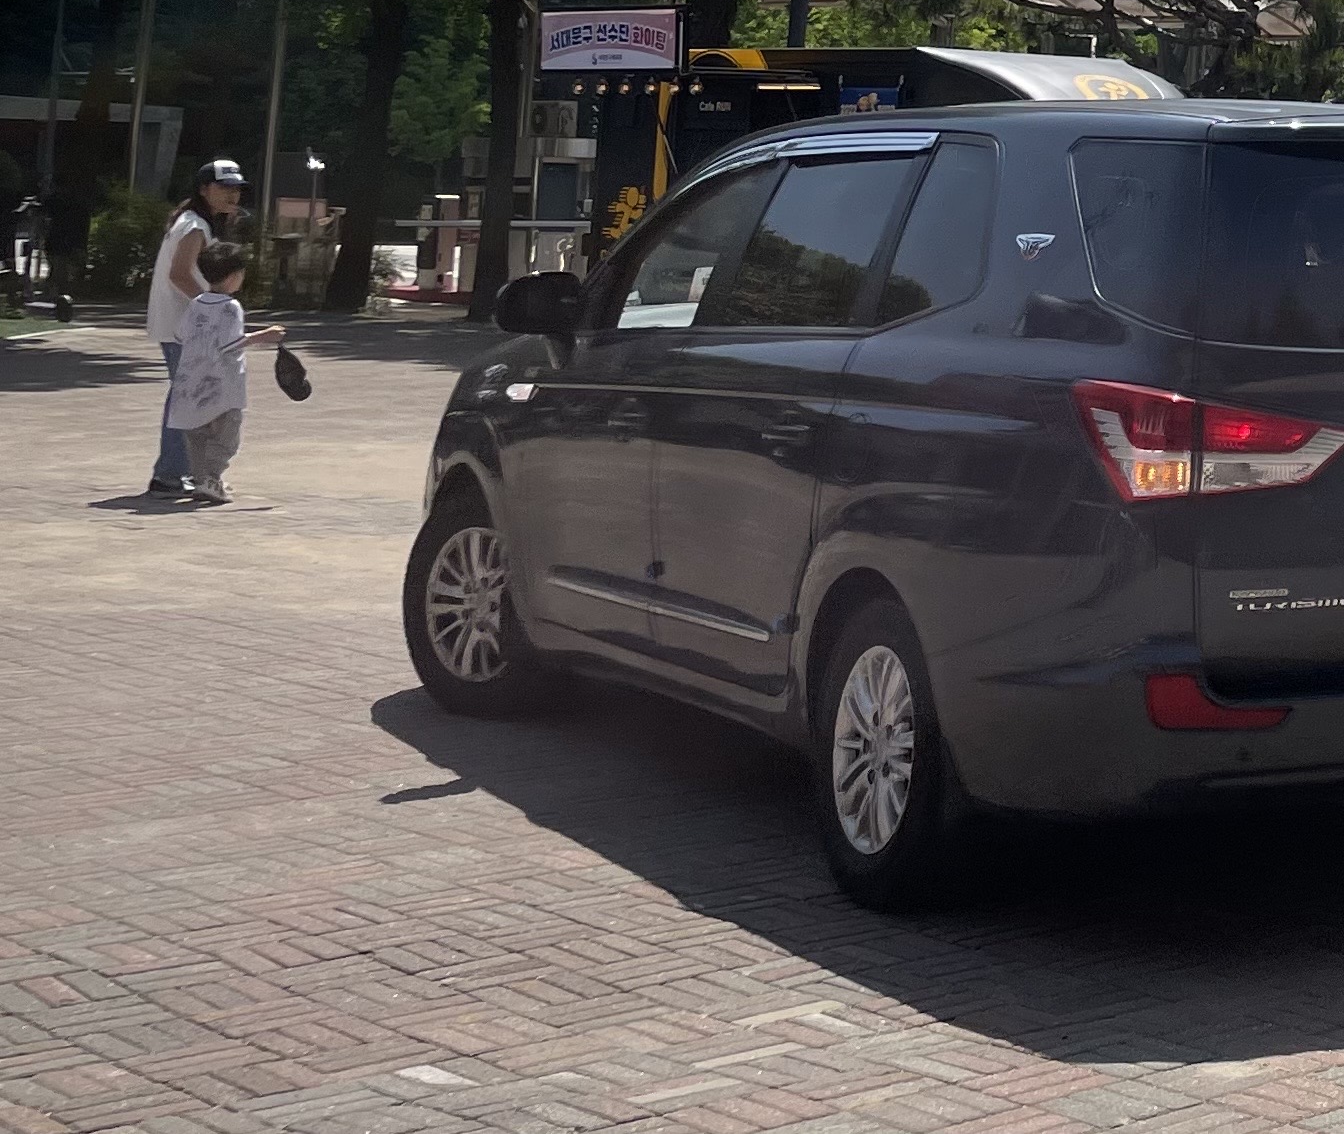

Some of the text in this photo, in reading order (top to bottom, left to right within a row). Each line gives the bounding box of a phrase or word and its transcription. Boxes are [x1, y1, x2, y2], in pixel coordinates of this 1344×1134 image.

[550, 23, 667, 51] 서대문구 선수단 화이팅
